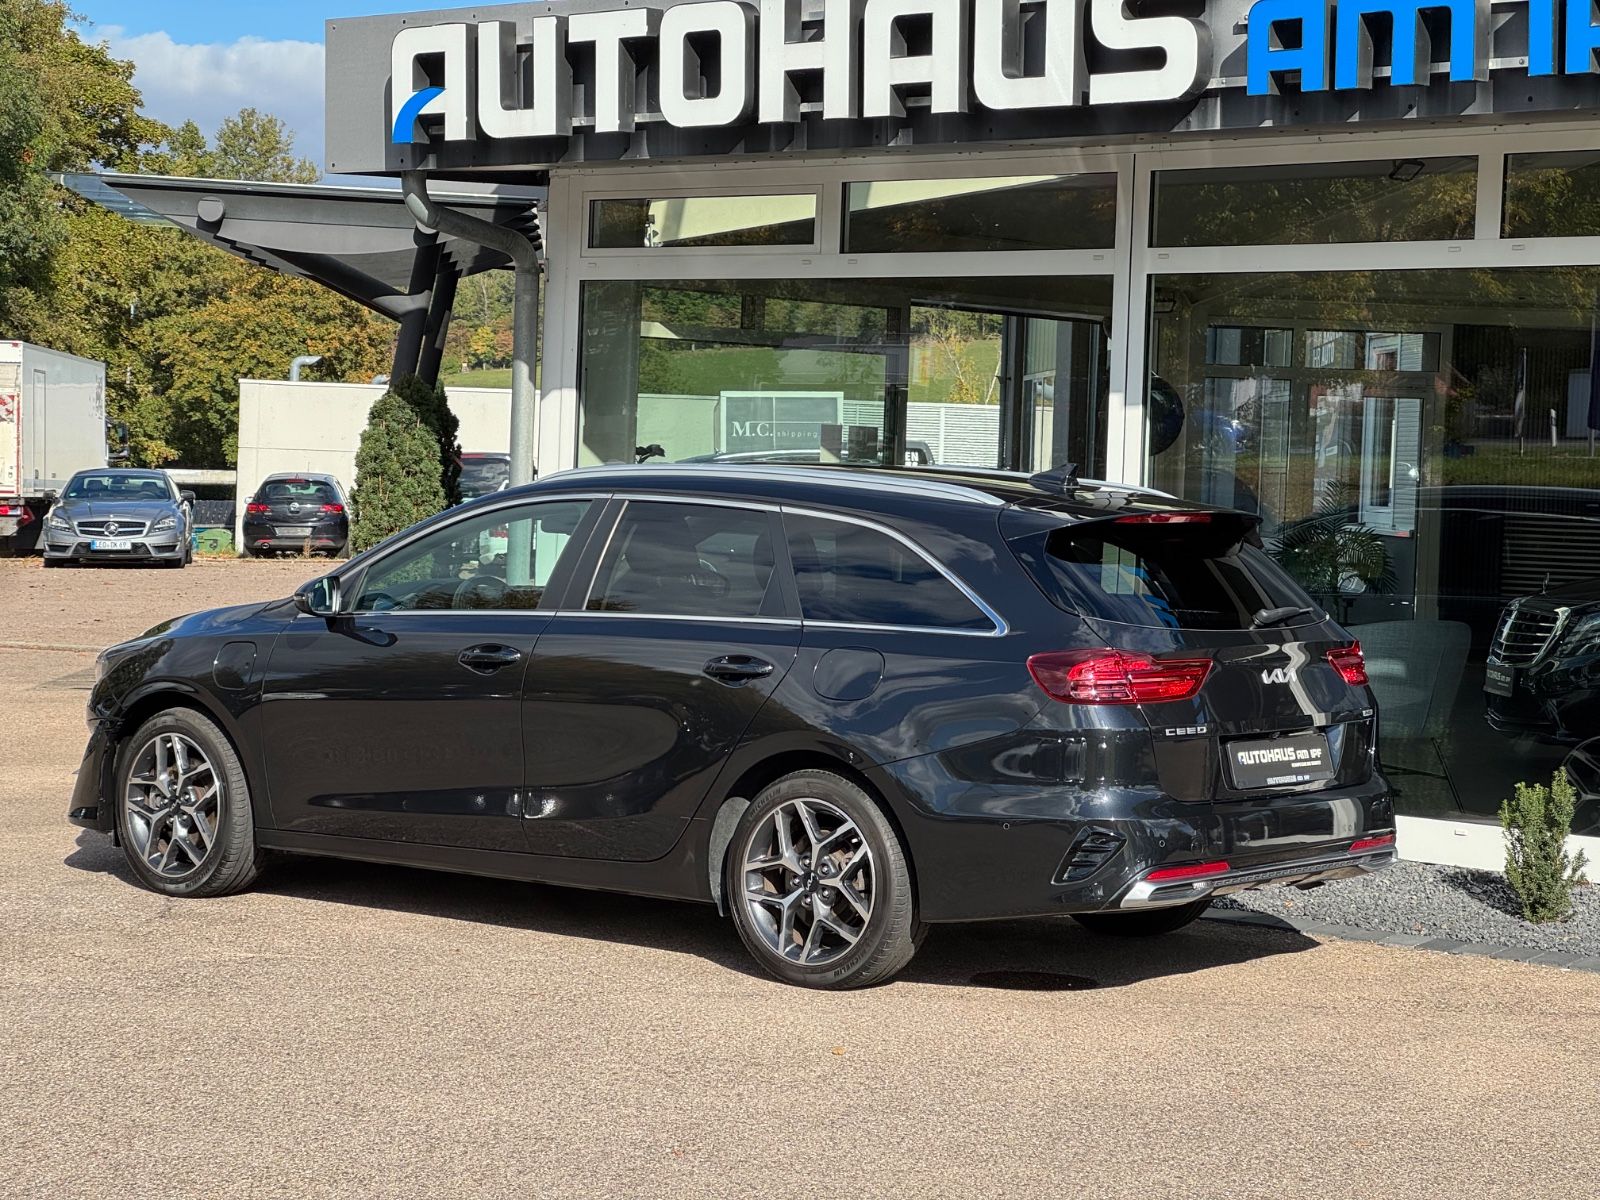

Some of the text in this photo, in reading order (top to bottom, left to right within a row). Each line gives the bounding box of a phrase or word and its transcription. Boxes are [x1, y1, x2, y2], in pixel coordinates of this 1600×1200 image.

[391, 0, 1200, 144] AUTOHAUS
[1246, 0, 1476, 96] AM
[732, 420, 773, 437] M.C.
[1261, 668, 1298, 684] KIA
[1165, 726, 1207, 736] CEED
[1237, 747, 1296, 765] AUTOHAUS
